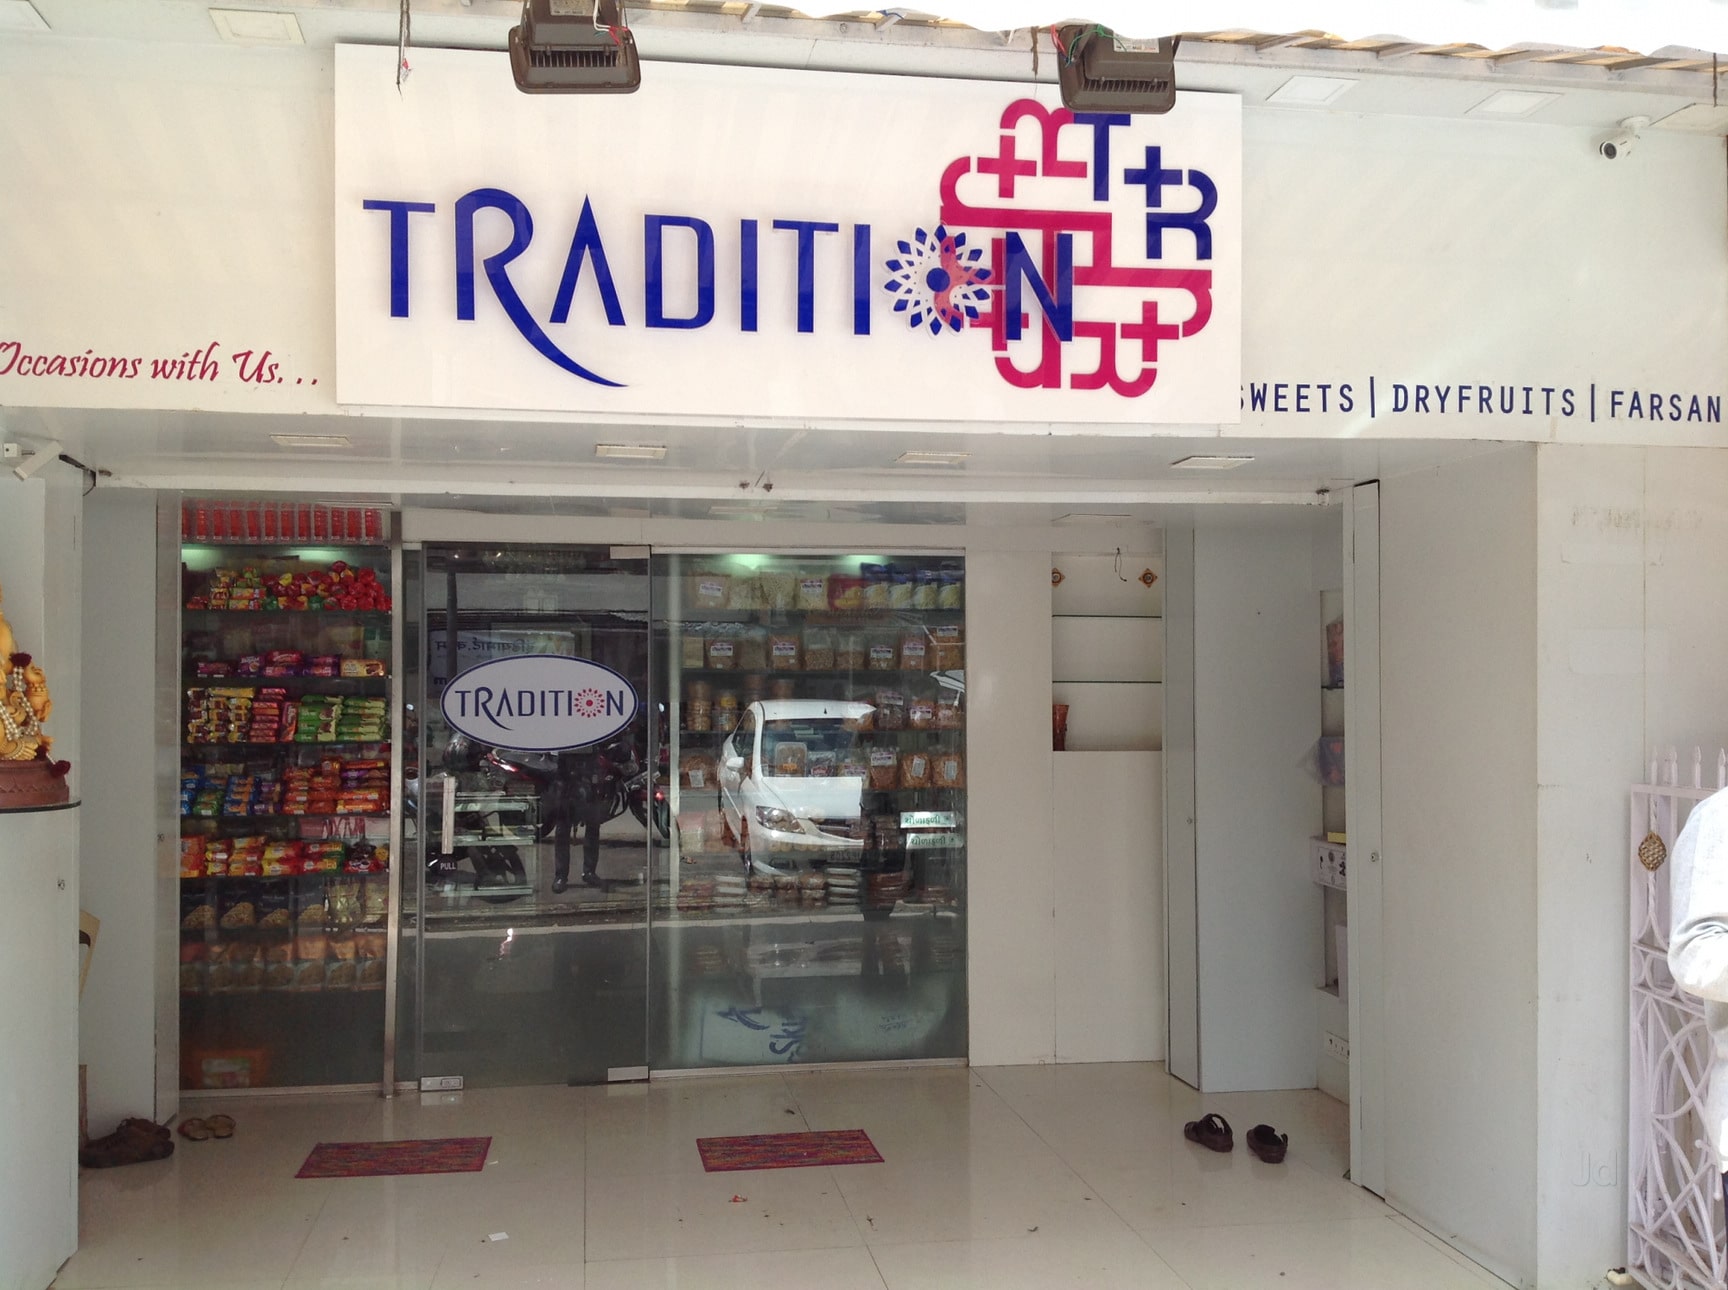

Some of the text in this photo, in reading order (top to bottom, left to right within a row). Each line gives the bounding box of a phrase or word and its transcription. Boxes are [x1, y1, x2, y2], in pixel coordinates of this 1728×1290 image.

[362, 187, 1073, 388] TRADITION
[0, 341, 142, 378] Occasions
[150, 341, 220, 382] with
[1392, 384, 1575, 417] DRYFRUITS
[1611, 391, 1721, 423] FARSAN
[454, 686, 624, 731] TRADITION
[440, 862, 457, 870] PULL
